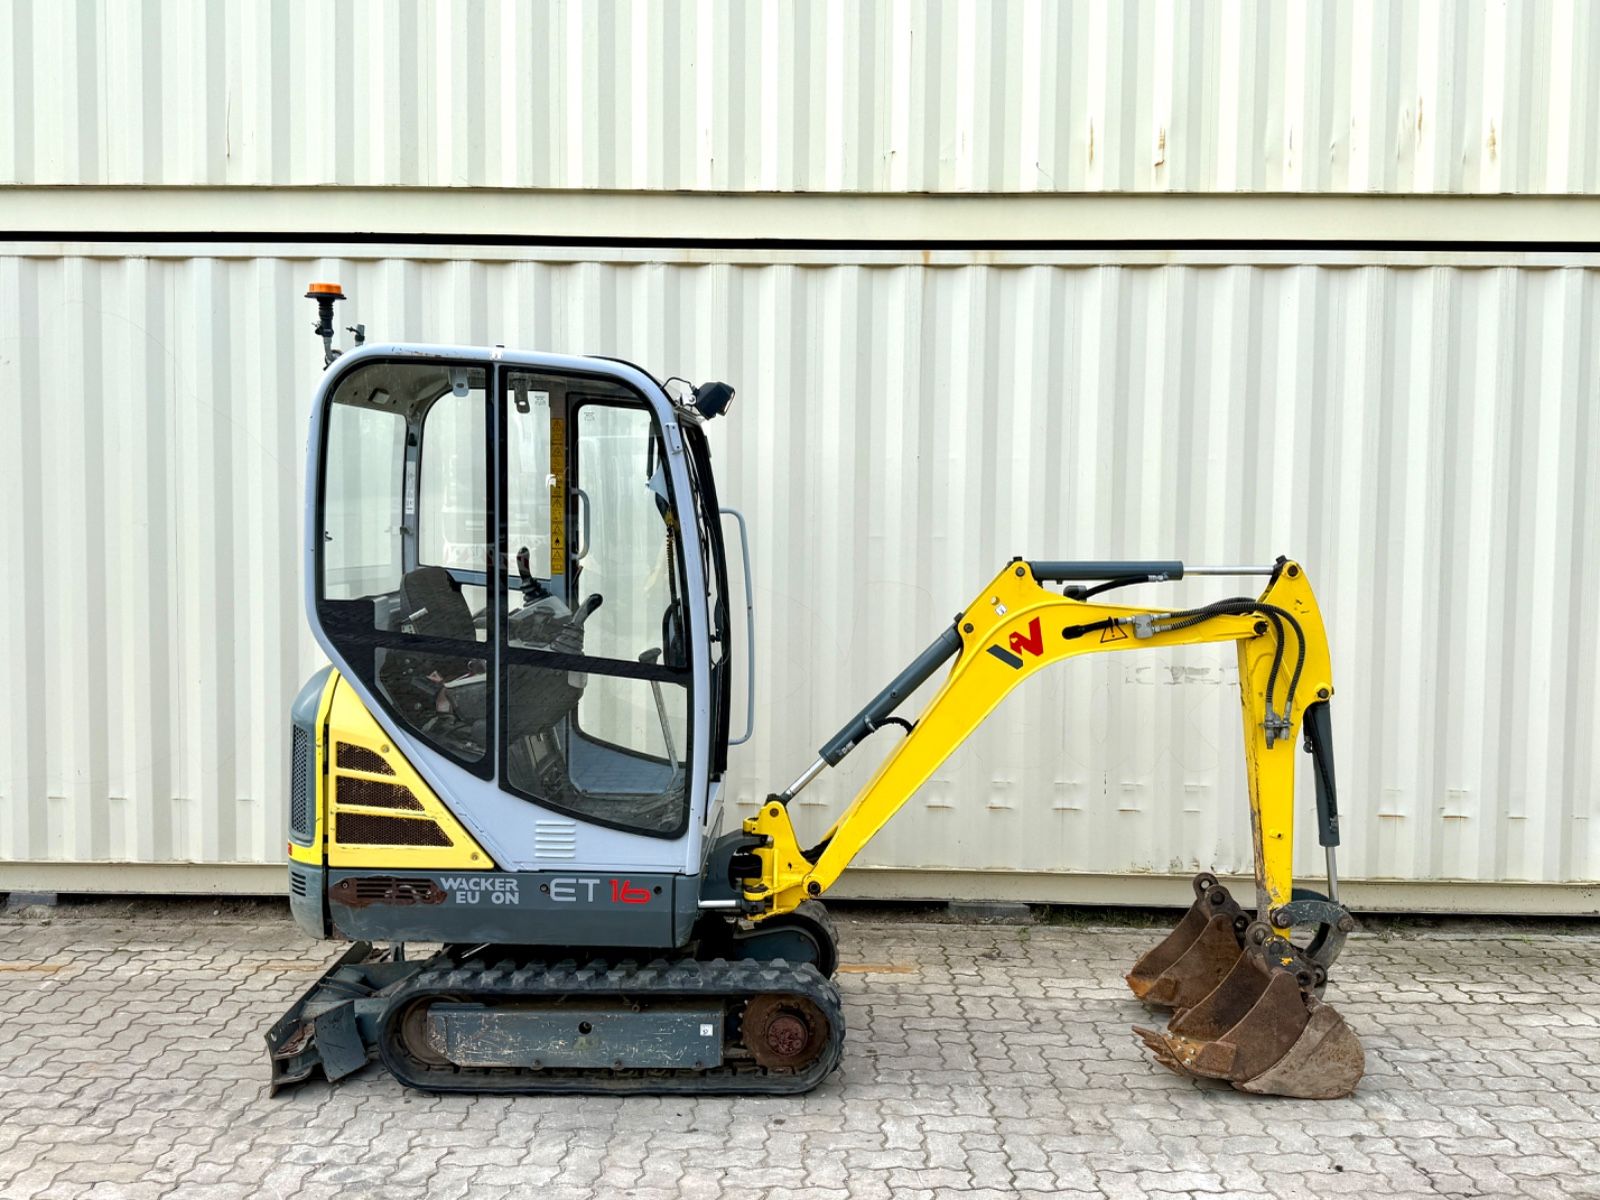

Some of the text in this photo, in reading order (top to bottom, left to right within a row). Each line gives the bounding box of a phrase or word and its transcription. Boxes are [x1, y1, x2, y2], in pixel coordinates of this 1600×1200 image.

[440, 877, 519, 891] WACKER
[549, 878, 651, 904] ET 16
